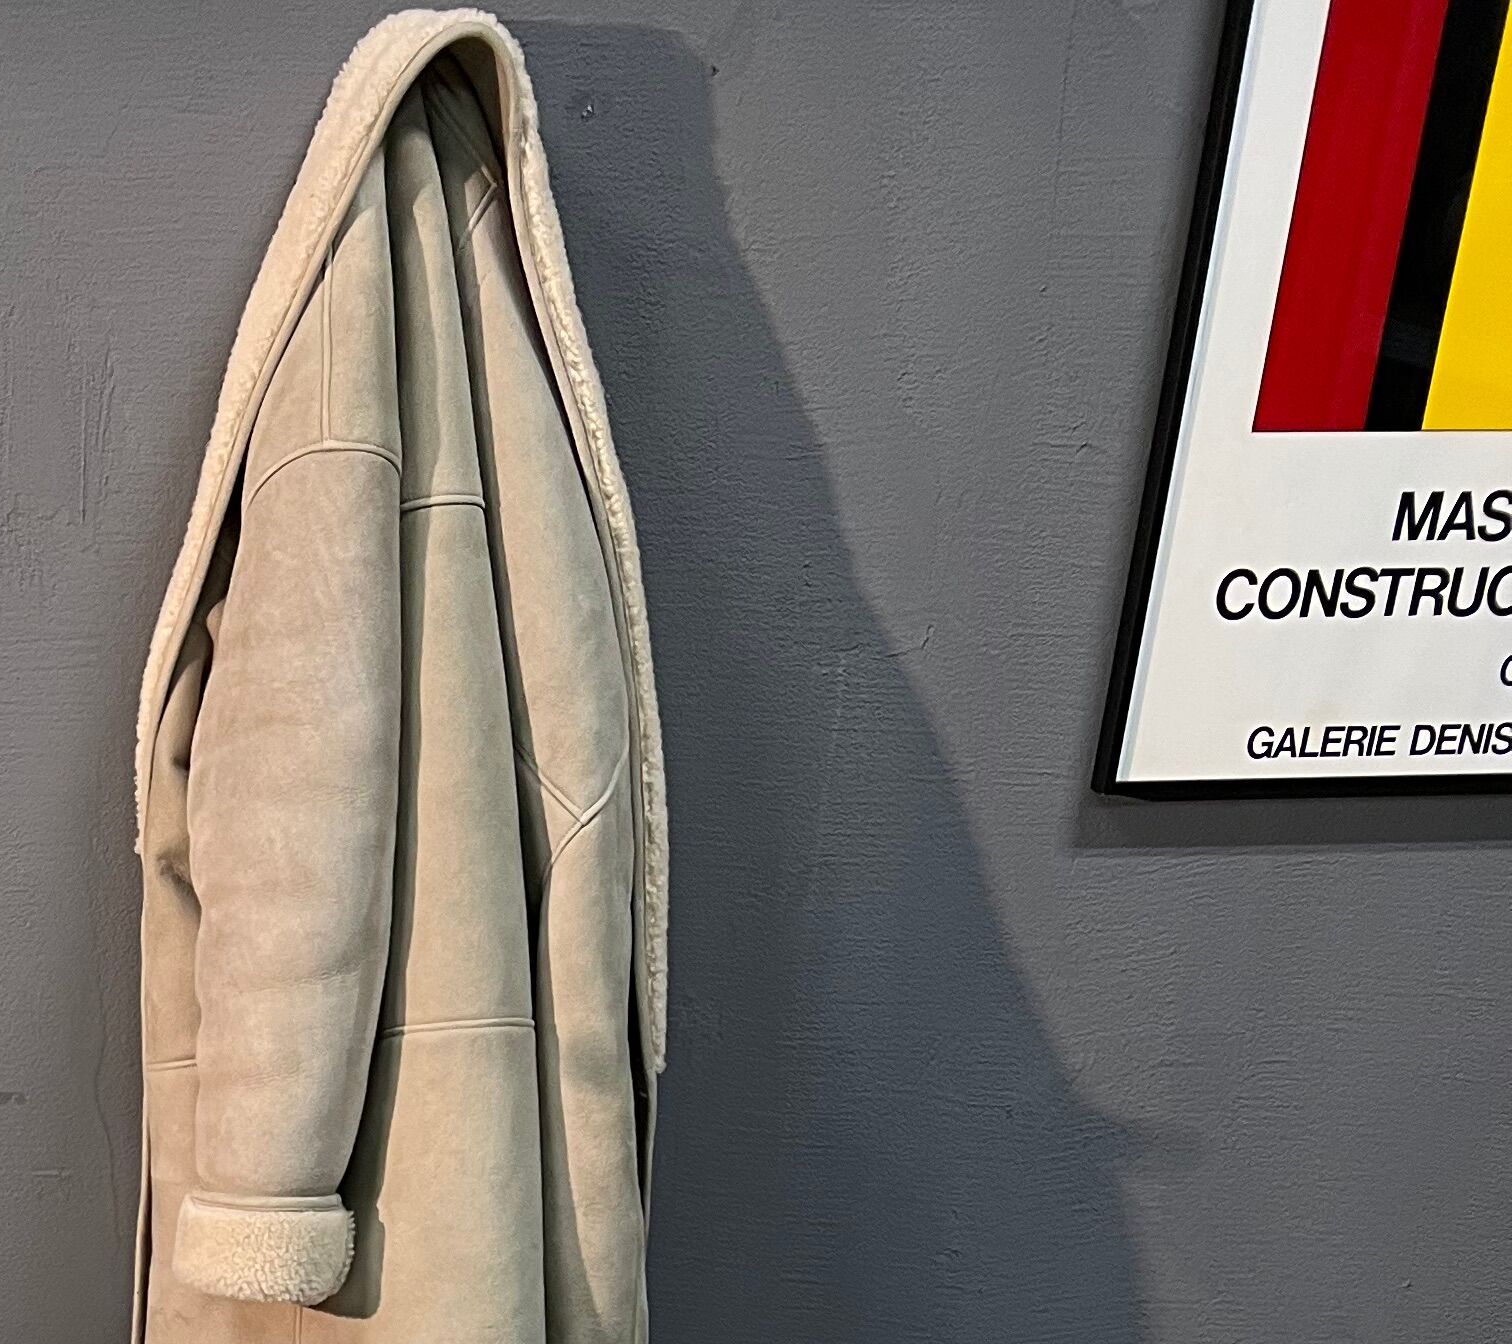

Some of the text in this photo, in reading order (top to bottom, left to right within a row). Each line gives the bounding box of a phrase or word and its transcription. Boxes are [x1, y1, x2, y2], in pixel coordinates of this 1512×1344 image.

[1392, 490, 1512, 542] MAS
[1246, 722, 1512, 760] GALERIE DENIS
